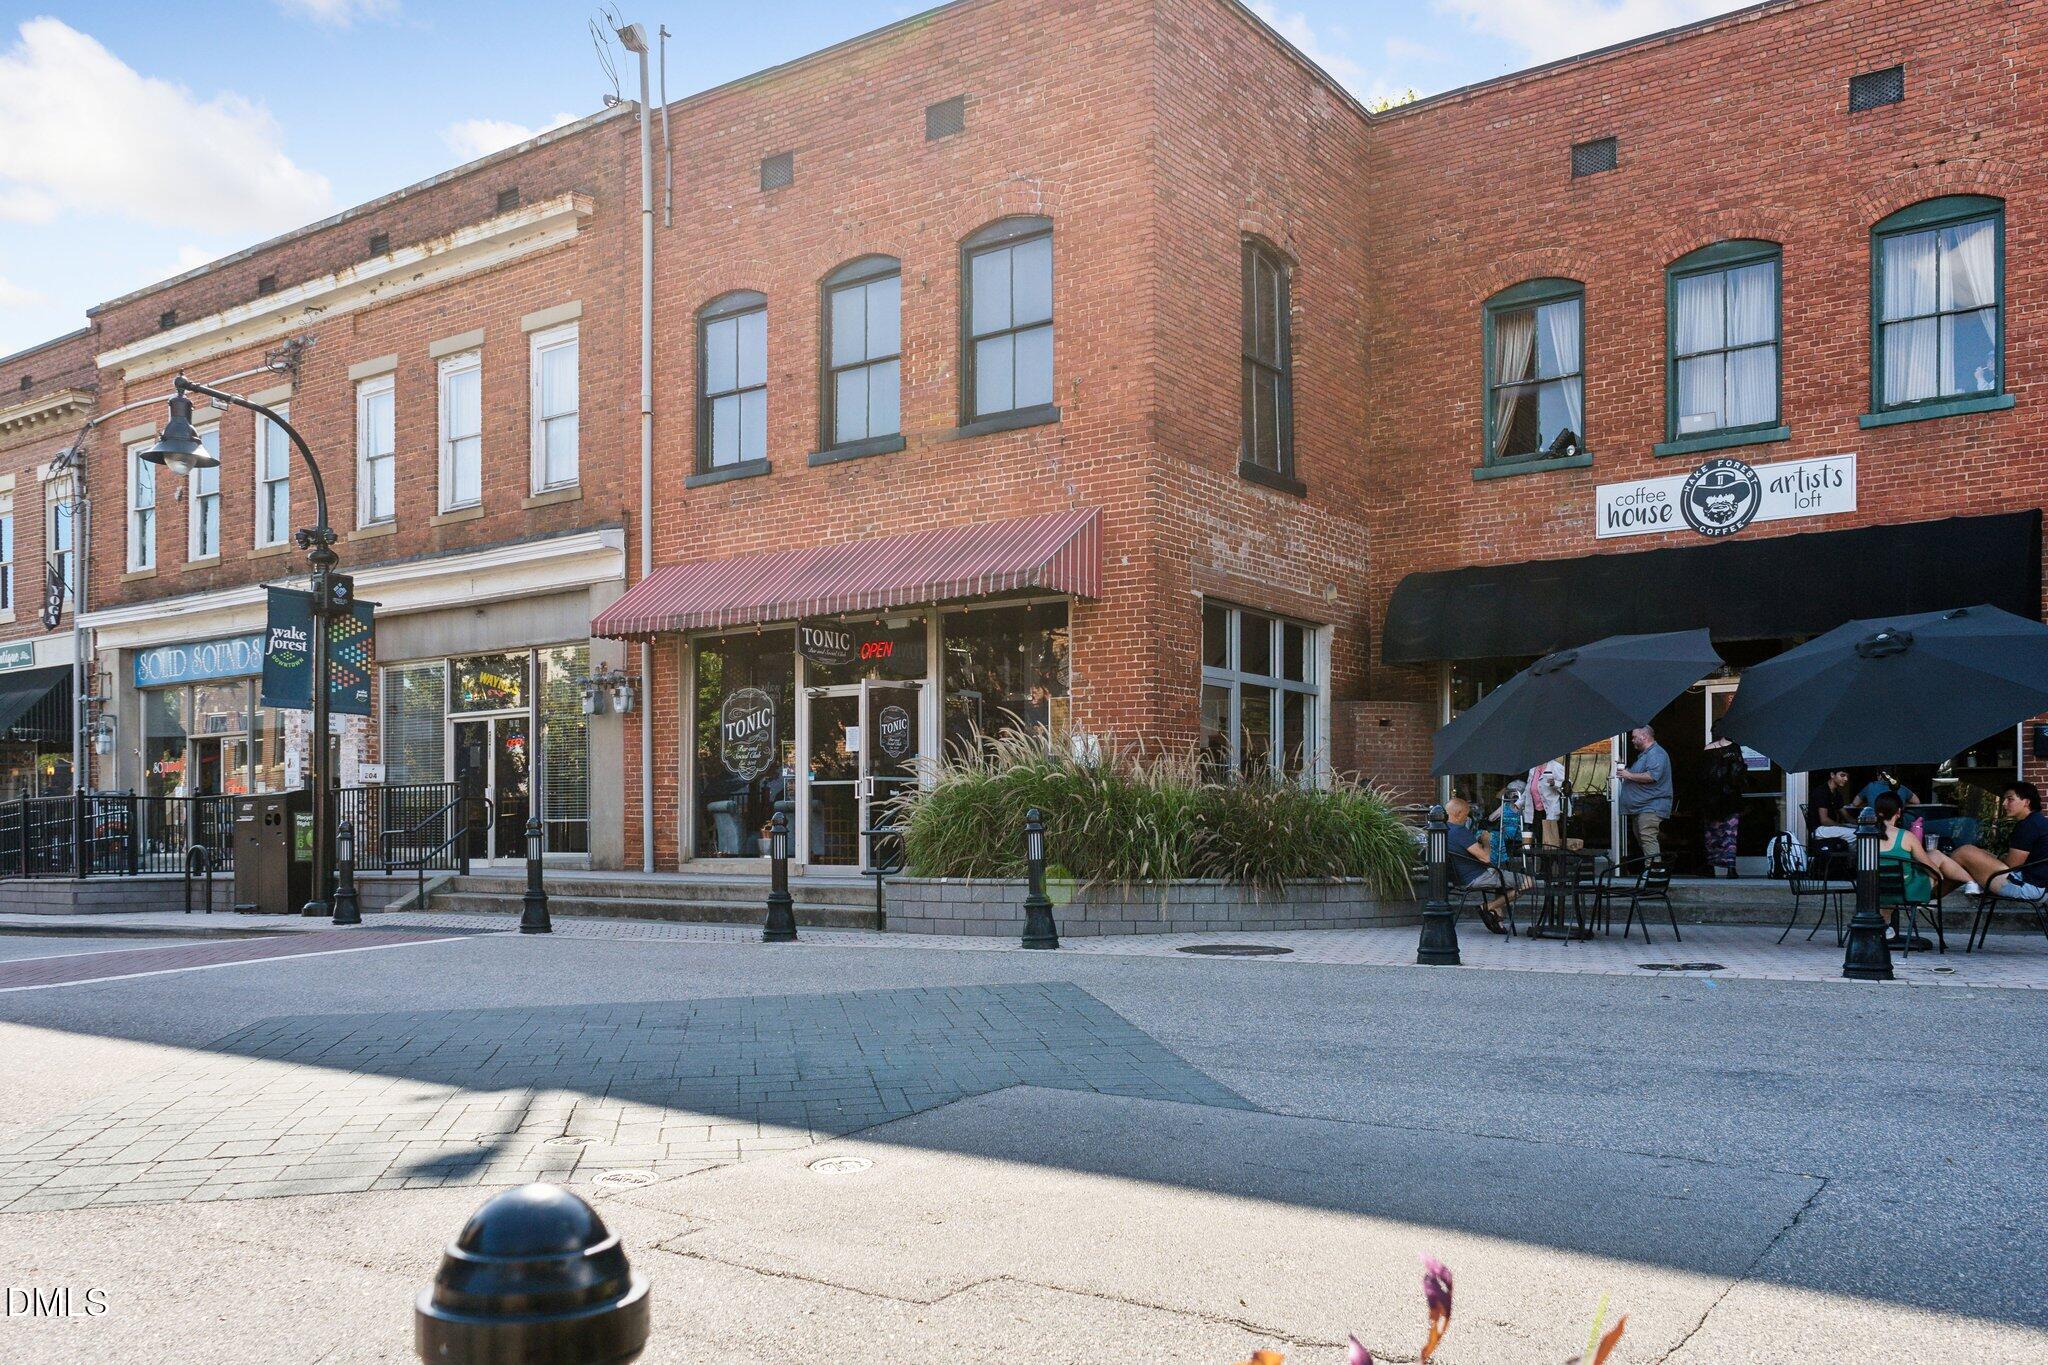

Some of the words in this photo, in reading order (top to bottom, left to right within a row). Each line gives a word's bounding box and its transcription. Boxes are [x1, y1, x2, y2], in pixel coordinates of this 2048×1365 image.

[1683, 464, 1709, 493] WAKE
[1716, 459, 1759, 485] FOREST
[1769, 463, 1845, 494] artist's
[1615, 486, 1667, 507] coffee
[1793, 489, 1822, 510] loft
[1607, 502, 1673, 529] house
[1699, 518, 1745, 537] COFFEE
[47, 585, 62, 625] YOGA
[271, 626, 308, 641] wake
[801, 627, 850, 651] TONIC
[265, 636, 308, 656] forest
[860, 641, 894, 660] OPEN
[139, 649, 187, 680] SOLID
[191, 638, 263, 675] SOUNDS
[271, 654, 305, 670] DOWNTOWN
[725, 707, 771, 741] TONIC
[881, 718, 907, 735] TONIC
